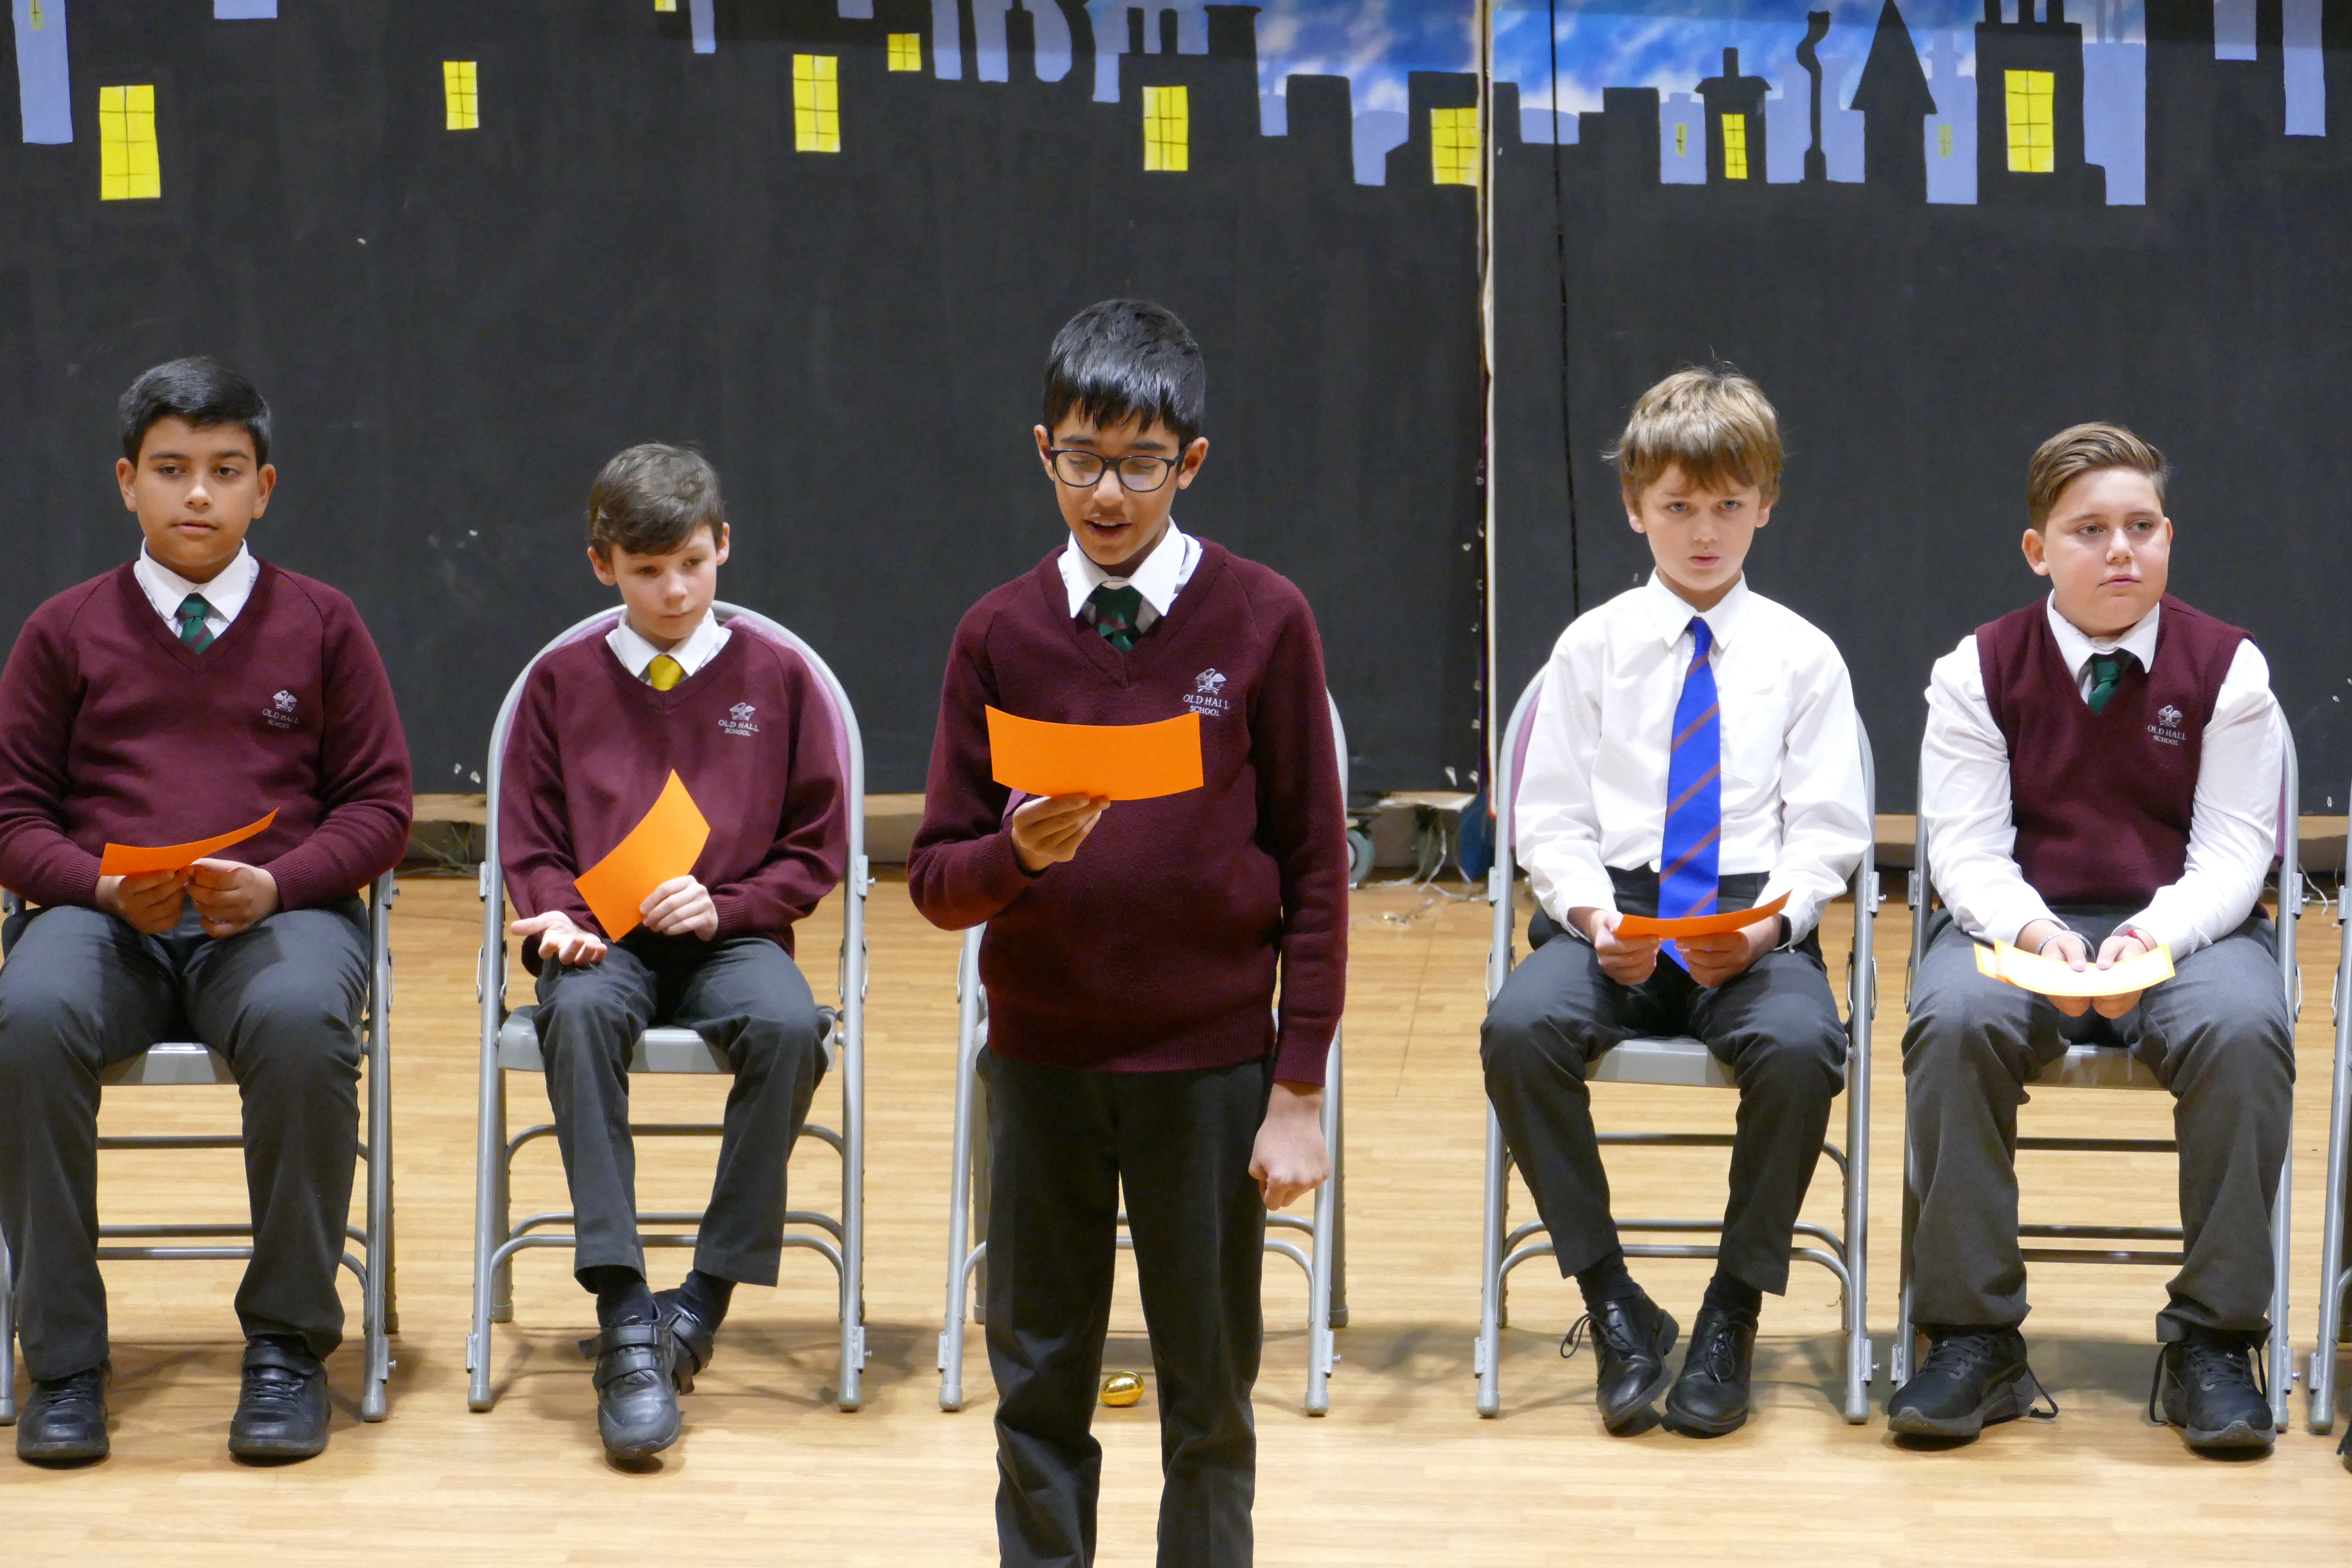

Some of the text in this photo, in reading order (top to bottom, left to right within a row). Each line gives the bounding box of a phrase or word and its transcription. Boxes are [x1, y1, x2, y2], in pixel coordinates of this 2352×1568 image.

[1183, 694, 1230, 709] OLD HALL
[263, 709, 299, 723] OLD HALL
[1189, 705, 1221, 716] SCHOOL
[718, 720, 760, 732] OLD HALL
[725, 728, 751, 736] SCHOOL
[2147, 725, 2187, 740] OLD HALL
[2153, 735, 2179, 746] SCHOOL
